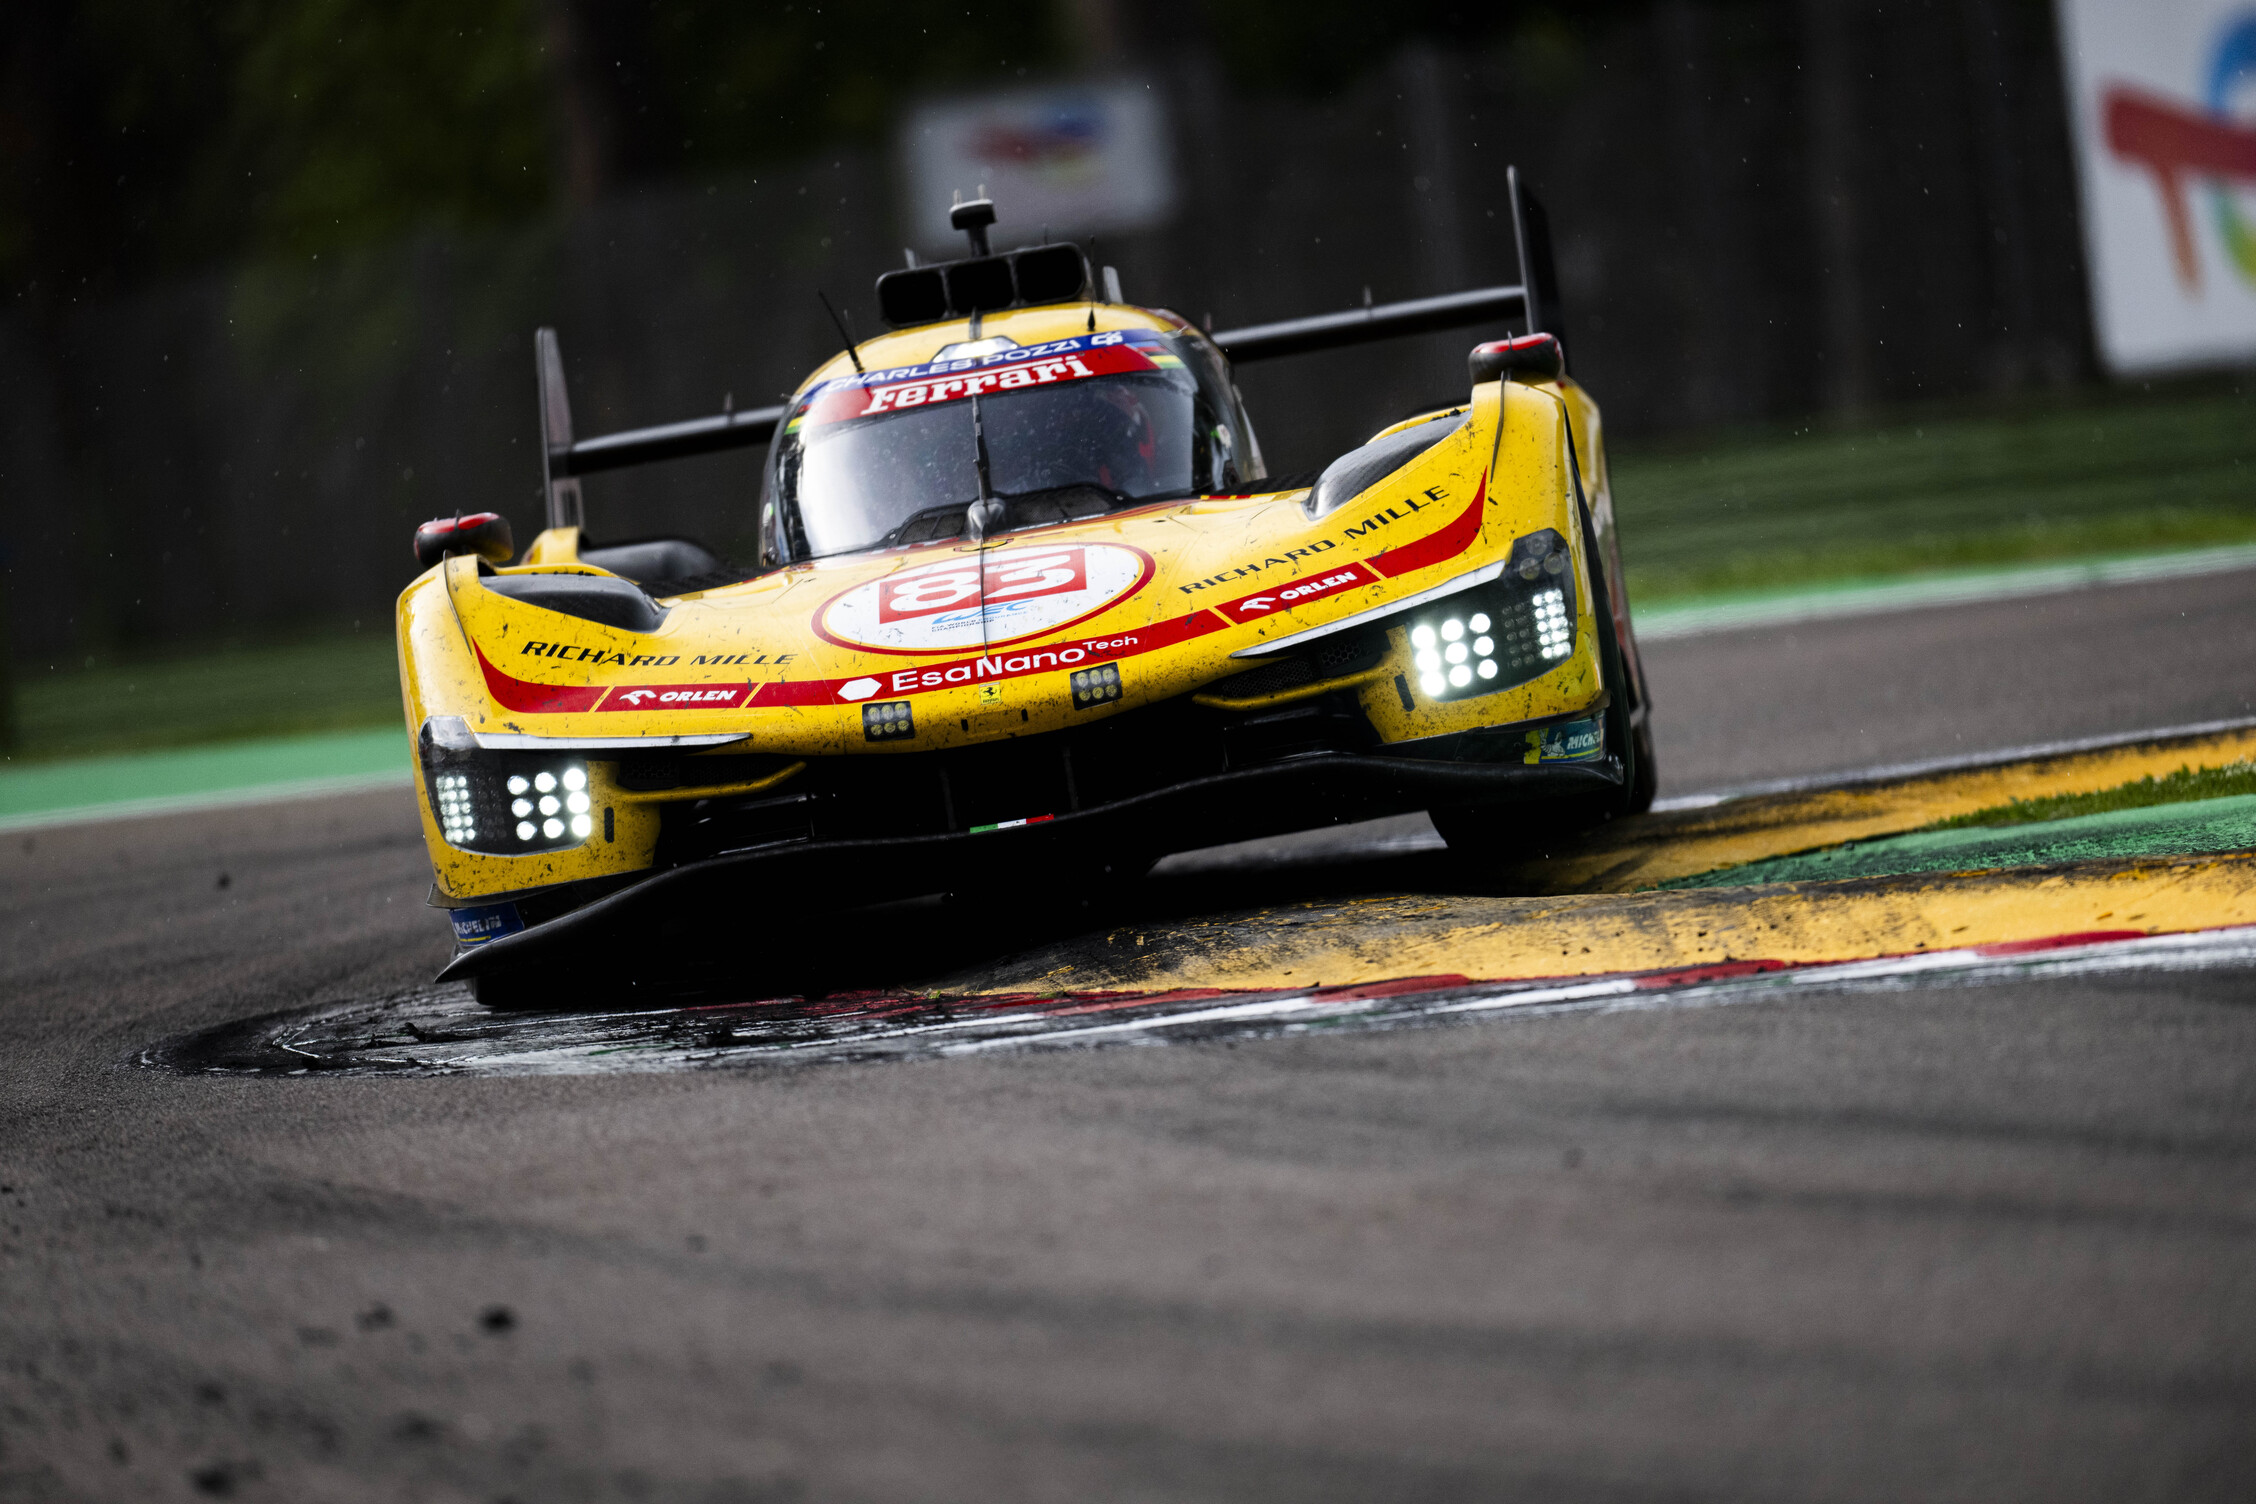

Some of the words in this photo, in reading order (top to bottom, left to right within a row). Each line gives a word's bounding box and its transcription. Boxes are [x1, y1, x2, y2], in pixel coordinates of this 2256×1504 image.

[825, 358, 973, 392] CHARLES
[983, 340, 1082, 365] POZZI
[860, 355, 1094, 415] Ferrari
[1178, 539, 1336, 594] RICHARD
[1344, 485, 1450, 540] MILLE
[888, 554, 1076, 612] 83
[1280, 571, 1358, 600] ORLEN
[521, 641, 680, 667] RICHARD
[690, 653, 798, 666] MILLE
[660, 690, 737, 702] ORLEN
